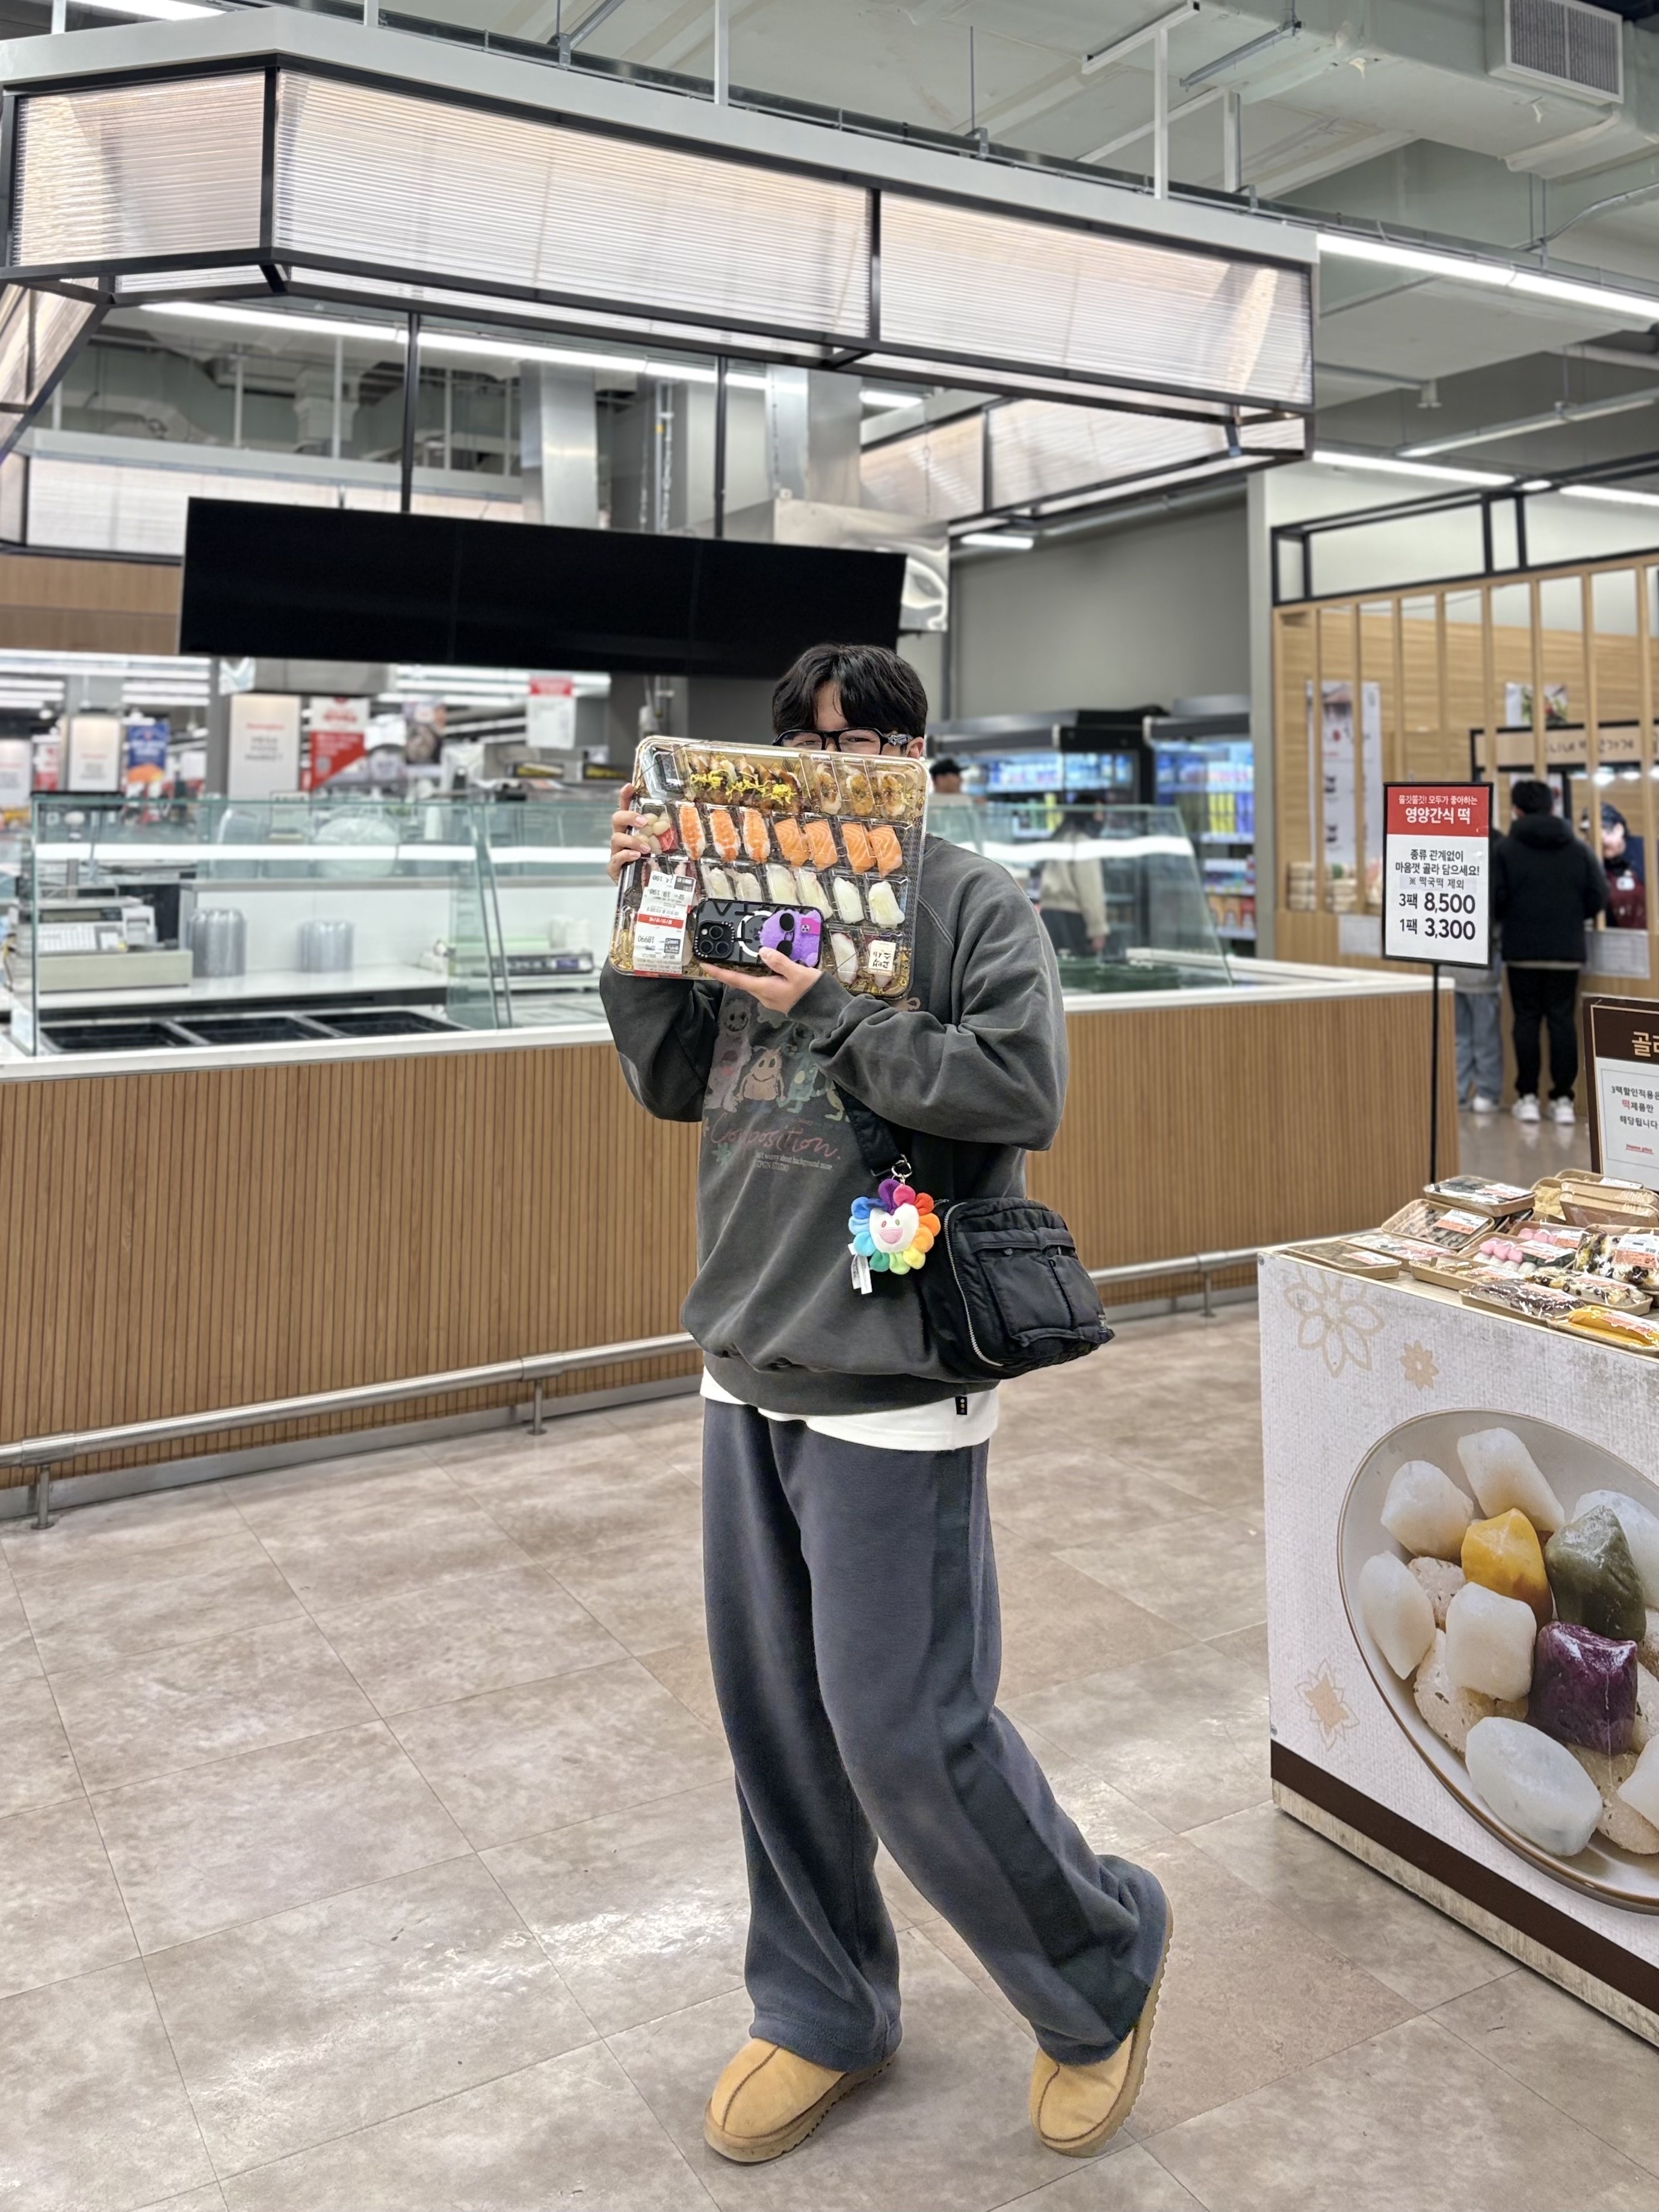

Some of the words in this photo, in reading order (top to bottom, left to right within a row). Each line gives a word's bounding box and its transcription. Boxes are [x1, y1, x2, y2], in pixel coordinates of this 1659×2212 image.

[1398, 795, 1427, 805] 쫄깃쫄깃!
[1428, 795, 1449, 805] 모두가
[1450, 795, 1478, 806] 좋아하는
[1405, 807, 1454, 824] 영양간식
[1457, 807, 1471, 825] 떡
[1410, 849, 1427, 861] 종류
[1429, 849, 1463, 863] 관계없이
[1395, 861, 1420, 874] 마음껏
[1423, 863, 1440, 875] 골라
[1442, 864, 1480, 876] 담으세요!
[1419, 876, 1444, 889] 떡국떡
[1447, 878, 1464, 890] 제외
[1399, 893, 1418, 910] 3팩
[1424, 892, 1475, 914] 8,500
[1400, 919, 1418, 935] 1팩
[1424, 917, 1475, 940] 3,300
[1622, 1099, 1654, 1114] 떡제품만
[1620, 1115, 1658, 1130] 해당됩니다
